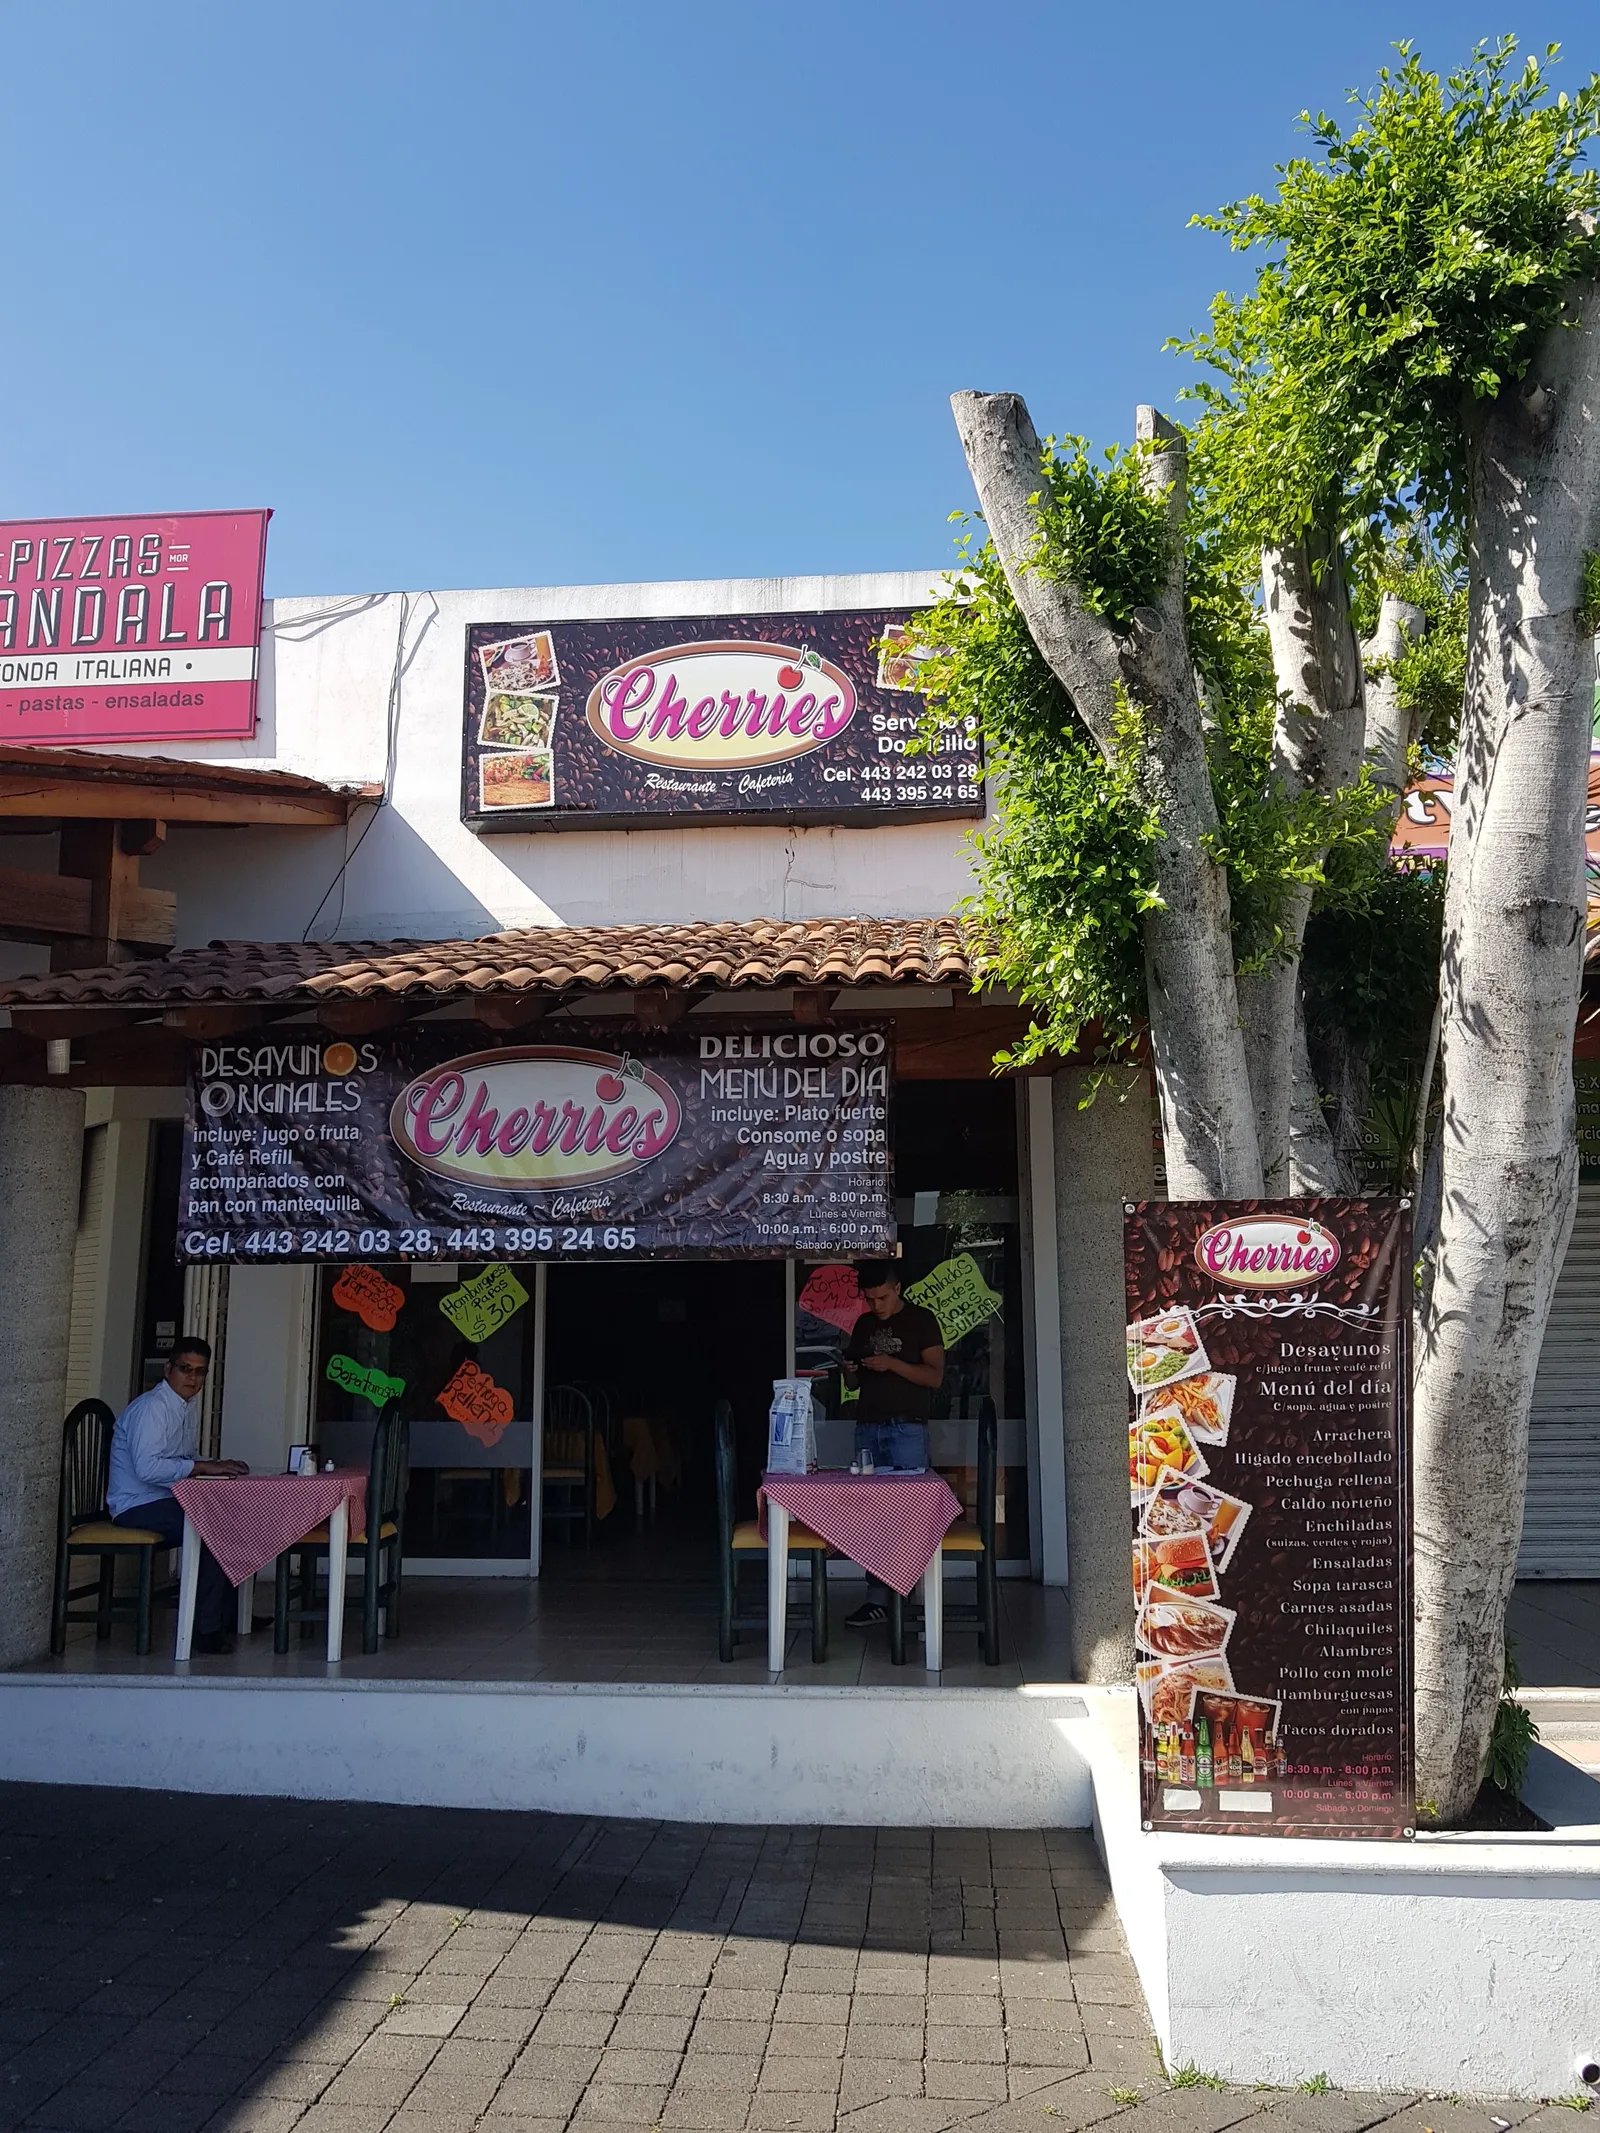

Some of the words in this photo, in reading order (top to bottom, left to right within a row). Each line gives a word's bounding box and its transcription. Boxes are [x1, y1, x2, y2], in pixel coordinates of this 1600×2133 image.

[8, 534, 162, 582] PIZZAS
[169, 554, 189, 562] MOR
[0, 662, 57, 682] ONDA
[75, 657, 171, 679] ITALIANA
[19, 696, 84, 715] pastas
[105, 691, 204, 708] ensaladas
[602, 666, 847, 741] Cherries
[878, 735, 977, 753] Doicilio
[823, 767, 856, 782] Cel.
[861, 767, 891, 780] 443
[896, 765, 926, 779] 242
[931, 764, 952, 778] 03
[957, 764, 978, 778] 28
[643, 773, 717, 793] Restaurante
[738, 769, 794, 794] Cafetería
[861, 787, 891, 800] 443
[896, 786, 927, 800] 395
[932, 785, 952, 799] 24
[957, 784, 978, 799] 65
[700, 1033, 885, 1059] DELICIOSO
[202, 1042, 378, 1077] DESAYUNOS
[701, 1060, 777, 1099] MENÚ
[783, 1067, 835, 1098] DEL
[842, 1059, 886, 1098] DÍA
[406, 1071, 665, 1161] Cherries
[711, 1105, 779, 1125] incluye:
[785, 1105, 829, 1121] Plato
[834, 1104, 886, 1120] fuerte
[193, 1127, 257, 1146] incluye:
[261, 1126, 299, 1146] jugo
[304, 1125, 315, 1141] ó
[320, 1124, 359, 1140] fruta
[737, 1127, 821, 1144] Consome
[826, 1131, 838, 1143] o
[842, 1128, 886, 1146] sopa
[191, 1153, 202, 1170] y
[206, 1150, 244, 1167] Café
[250, 1149, 293, 1166] Refill
[763, 1149, 808, 1169] Agua
[814, 1152, 824, 1169] y
[829, 1149, 886, 1169] postre
[189, 1172, 309, 1193] acompañados
[314, 1174, 345, 1188] con
[848, 1177, 886, 1187] Horario:
[188, 1200, 219, 1217] pan
[224, 1199, 256, 1213] con
[262, 1195, 361, 1215] mantequilla
[450, 1192, 528, 1217] Restaurante
[551, 1191, 612, 1219] Cafetería
[763, 1193, 789, 1204] 8:30
[792, 1194, 819, 1203] a.m.
[829, 1192, 856, 1203] 8:00
[860, 1193, 887, 1204] p.m.
[809, 1209, 839, 1219] Lunes
[849, 1209, 887, 1218] Viernes
[756, 1224, 789, 1235] 10:00
[792, 1225, 819, 1234] a.m.
[829, 1223, 856, 1234] 6:00
[860, 1224, 887, 1236] p.m.
[184, 1231, 236, 1255] Cel.
[245, 1231, 293, 1254] 443
[302, 1230, 350, 1253] 242
[358, 1229, 391, 1253] 03
[399, 1228, 439, 1256] 28,
[447, 1228, 496, 1251] 443
[504, 1228, 553, 1251] 395
[562, 1228, 595, 1250] 24
[603, 1228, 636, 1250] 65
[795, 1240, 833, 1250] Sábado
[835, 1242, 841, 1251] y
[843, 1240, 887, 1251] Domingo
[1203, 1229, 1333, 1274] Cherries
[1280, 1342, 1391, 1361] Desayunos
[1255, 1363, 1291, 1375] c/jugo
[1294, 1365, 1301, 1373] o
[1304, 1363, 1332, 1373] fruta
[1334, 1365, 1341, 1374] y
[1344, 1361, 1367, 1372] café
[1369, 1361, 1392, 1371] refil
[1259, 1380, 1316, 1396] Menú
[1323, 1379, 1353, 1396] del
[1361, 1378, 1392, 1395] día
[1319, 1403, 1346, 1412] agua
[1349, 1403, 1356, 1413] y
[1358, 1400, 1392, 1412] postre
[1312, 1428, 1392, 1442] Arrachera
[1235, 1452, 1291, 1467] Higado
[1296, 1450, 1392, 1465] encebollado
[1265, 1475, 1333, 1490] Pechuga
[1338, 1474, 1392, 1487] rellena
[1281, 1497, 1326, 1510] Caldo
[1331, 1496, 1392, 1510] norteño
[1305, 1519, 1393, 1533] Enchiladas
[1312, 1537, 1349, 1547] verdes
[1351, 1538, 1358, 1549] y
[1361, 1535, 1393, 1547] rojas)
[1313, 1556, 1393, 1569] Ensaladas
[1292, 1580, 1331, 1595] Sopa
[1336, 1580, 1393, 1591] tarasca
[1280, 1601, 1335, 1614] Carnes
[1339, 1600, 1393, 1613] asadas
[1304, 1622, 1393, 1638] Chilaquiles
[1320, 1645, 1393, 1657] Alambres
[1279, 1667, 1319, 1679] Pollo
[1323, 1669, 1351, 1679] con
[1356, 1666, 1394, 1678] mole
[1276, 1688, 1394, 1703] Hamburguesas
[1340, 1707, 1360, 1715] con
[1362, 1706, 1394, 1716] papas
[1280, 1724, 1326, 1736] Tacos
[1331, 1723, 1394, 1736] dorados
[1362, 1753, 1395, 1762] Horario:
[1287, 1764, 1310, 1774] 8:30
[1313, 1766, 1336, 1774] a.m.
[1345, 1765, 1369, 1775] 8:00
[1371, 1765, 1394, 1777] p.m.
[1327, 1779, 1353, 1787] Lunes
[1363, 1779, 1394, 1788] Viernes
[1282, 1789, 1310, 1799] 10:00
[1313, 1791, 1336, 1799] a.m.
[1345, 1790, 1369, 1799] 6:00
[1371, 1791, 1394, 1801] p.m.
[1350, 1805, 1355, 1813] y
[1357, 1803, 1395, 1814] Domingo
